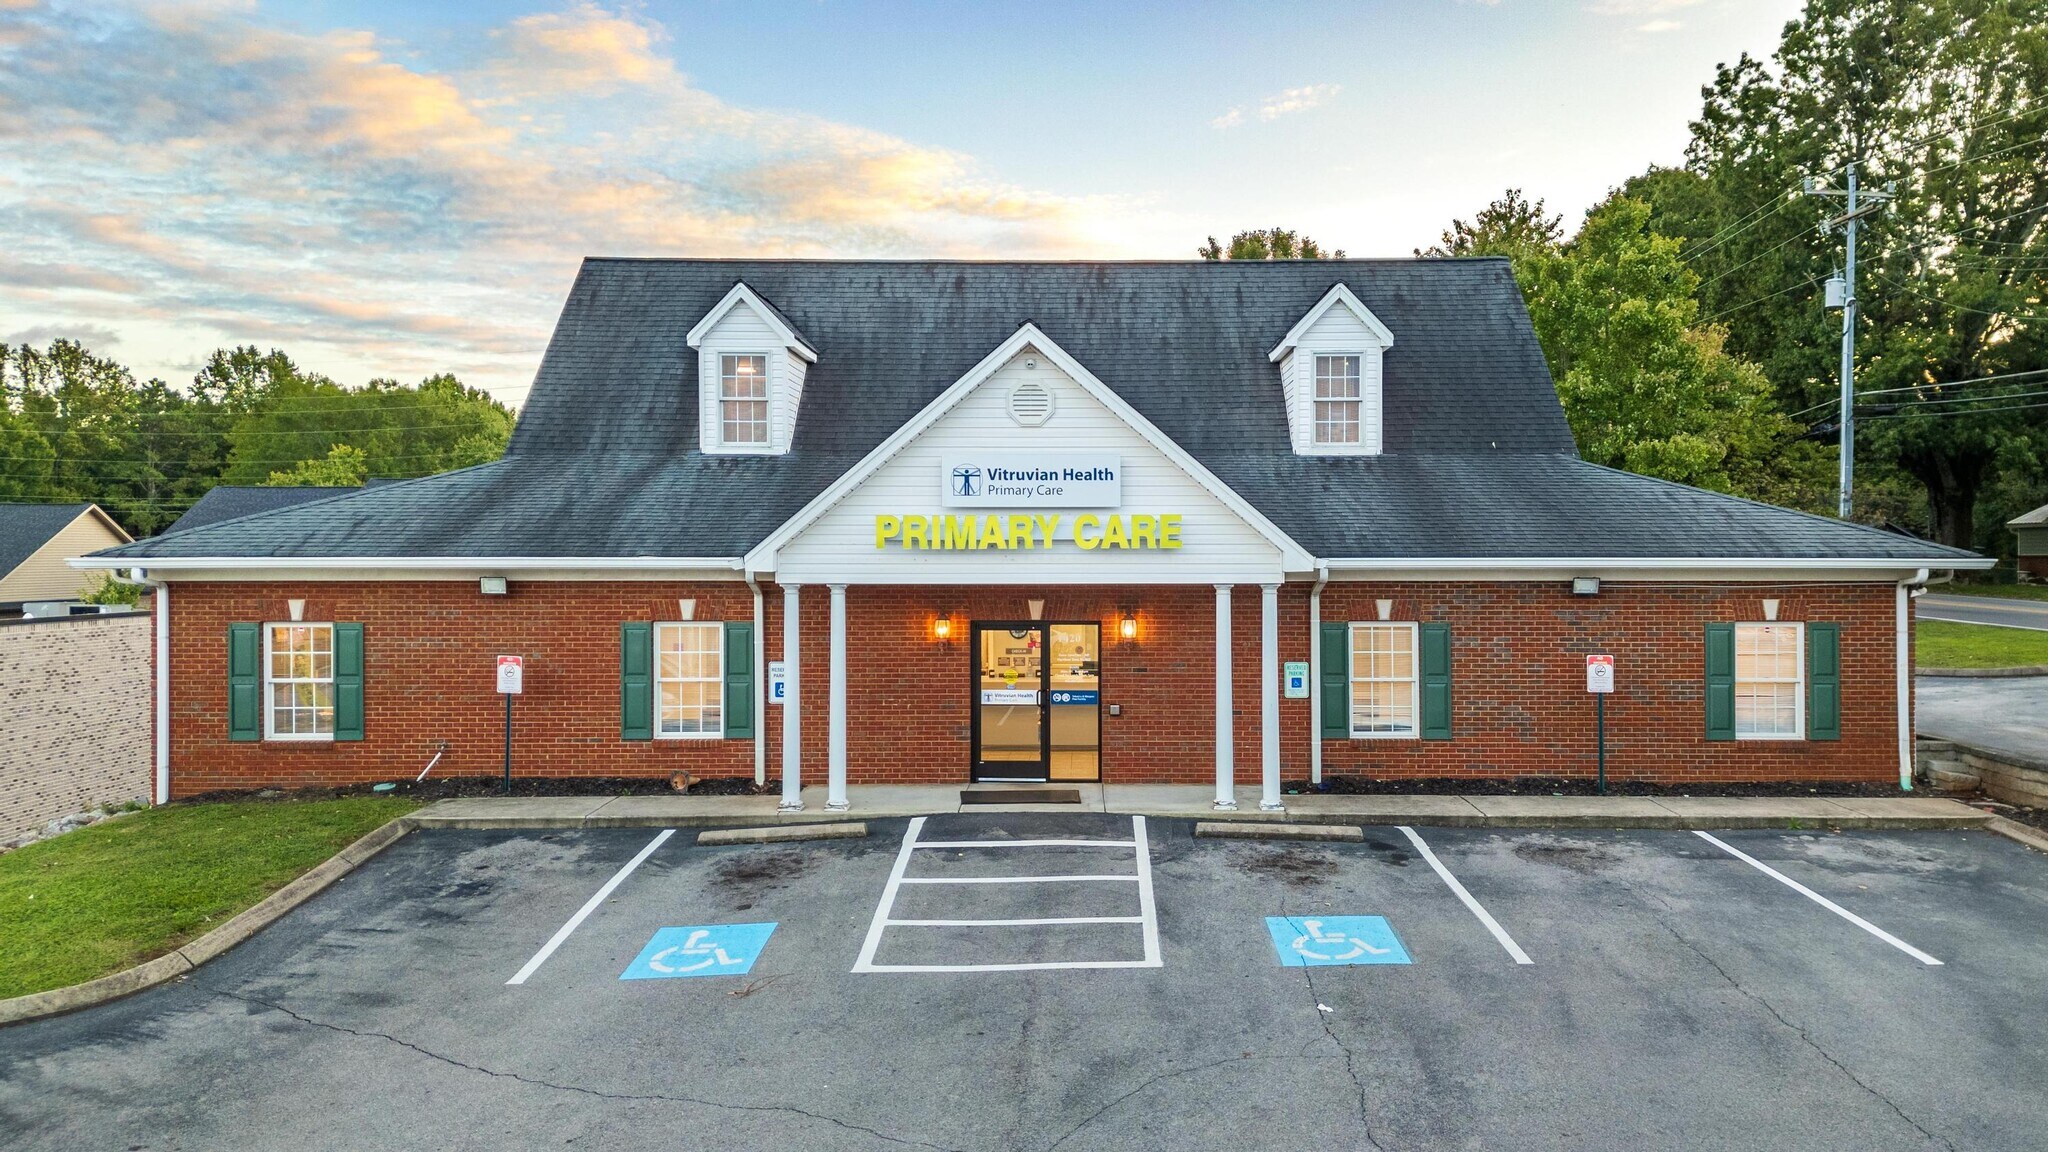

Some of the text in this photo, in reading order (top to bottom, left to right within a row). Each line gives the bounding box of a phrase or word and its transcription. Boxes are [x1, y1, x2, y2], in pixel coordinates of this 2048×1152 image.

[987, 467, 1114, 481] Vitruvian Health
[988, 484, 1063, 497] Primary Care
[875, 514, 1183, 550] PRIMARY CARE
